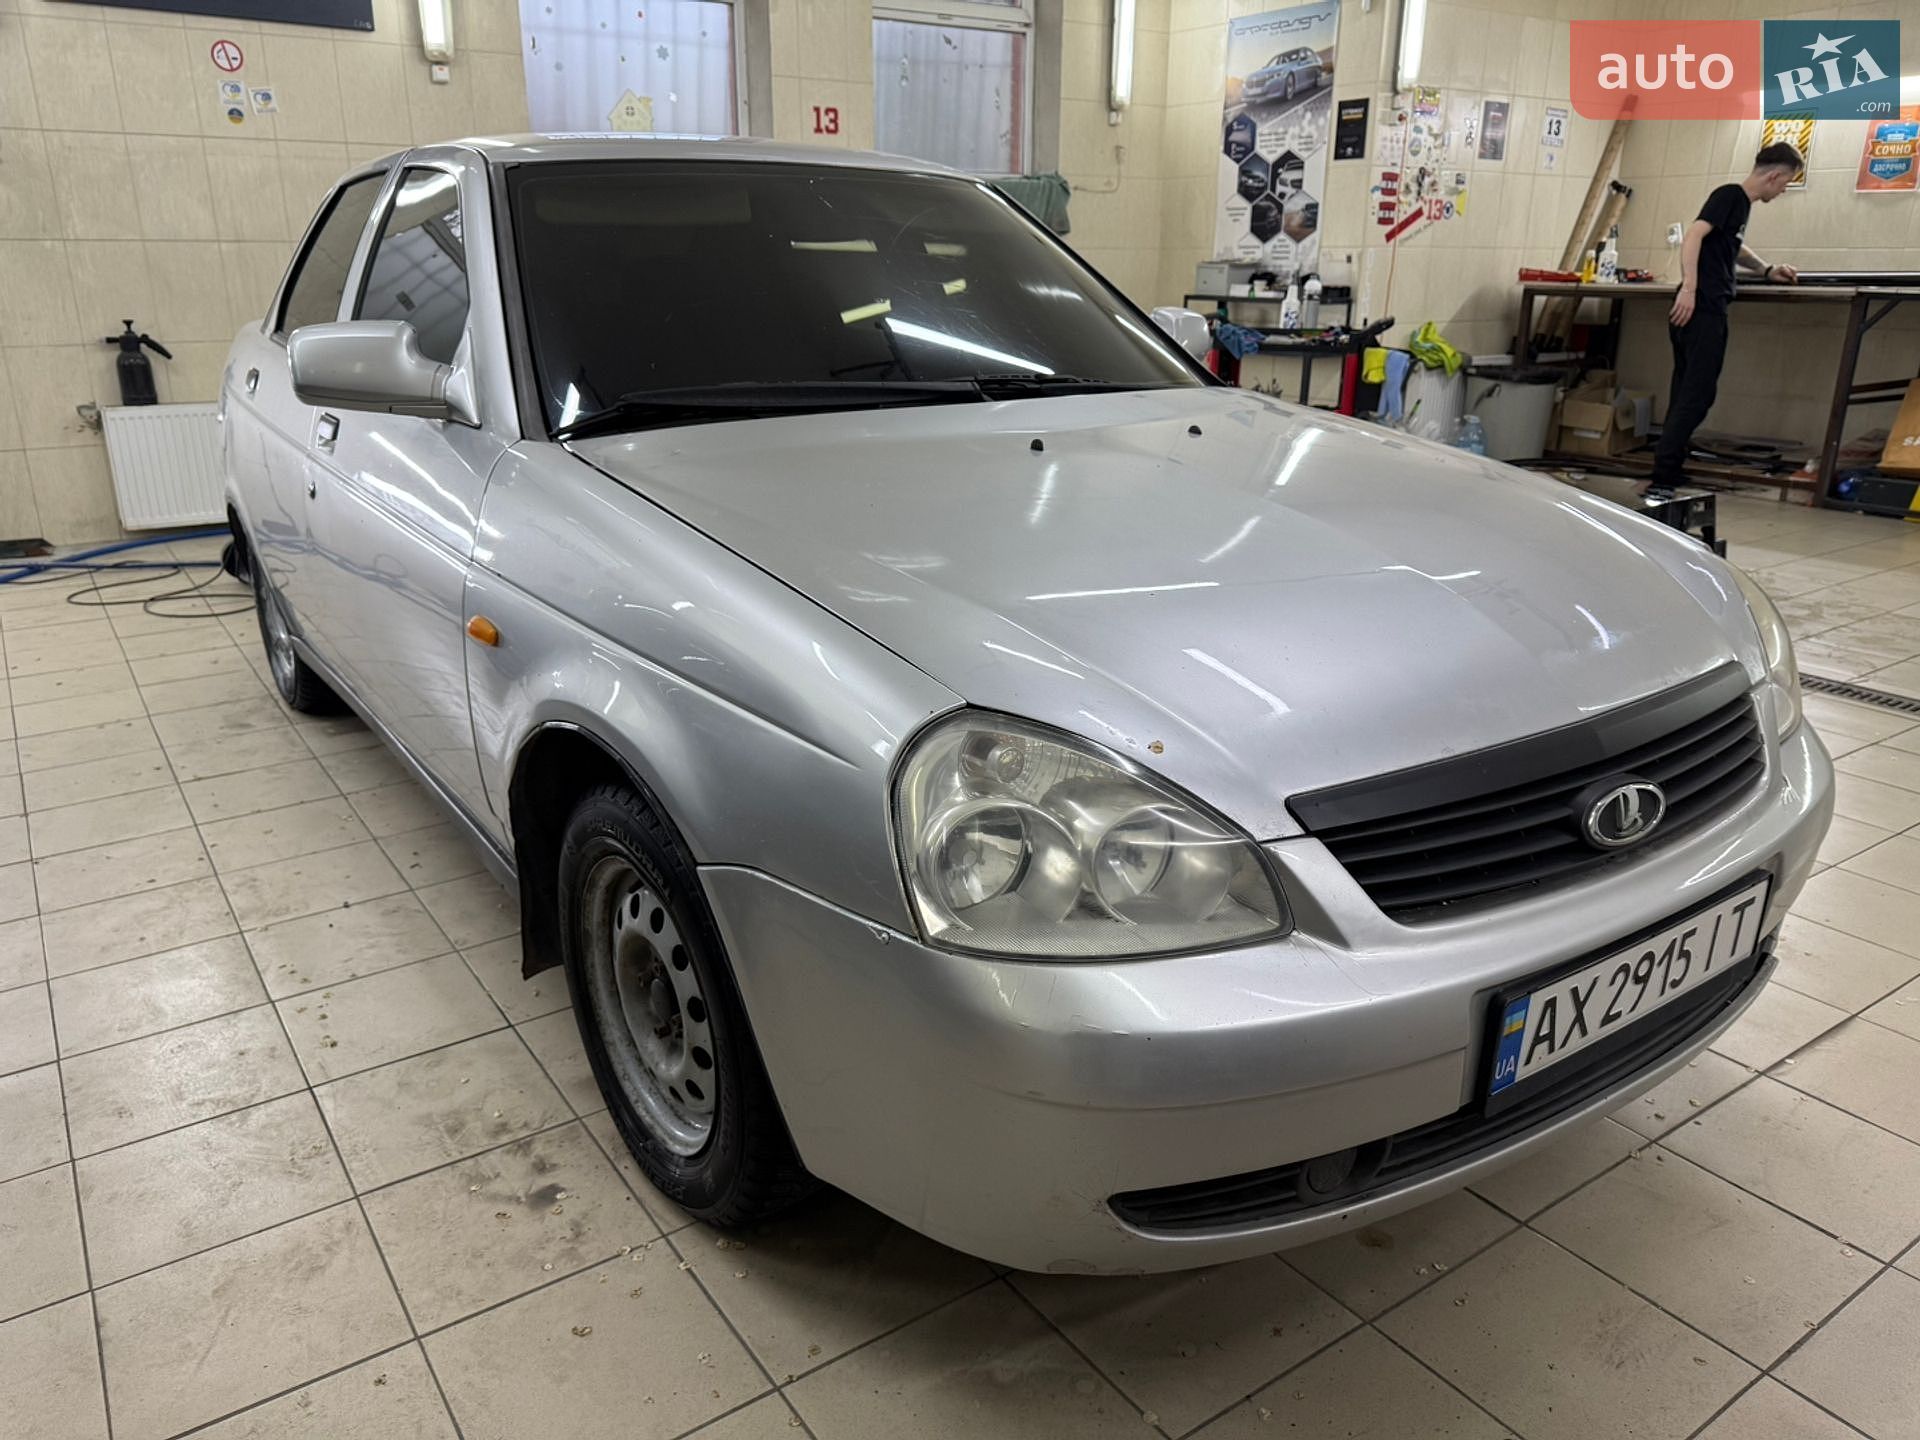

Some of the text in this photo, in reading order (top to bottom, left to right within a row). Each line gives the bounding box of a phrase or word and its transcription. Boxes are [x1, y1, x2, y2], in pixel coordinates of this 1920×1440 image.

[812, 106, 839, 135] 13
[1547, 119, 1562, 136] 13
[1875, 143, 1912, 155] СОЧНО
[1426, 199, 1444, 221] 13
[1524, 896, 1756, 1067] AX 2915 IT
[1495, 1055, 1515, 1080] UA
